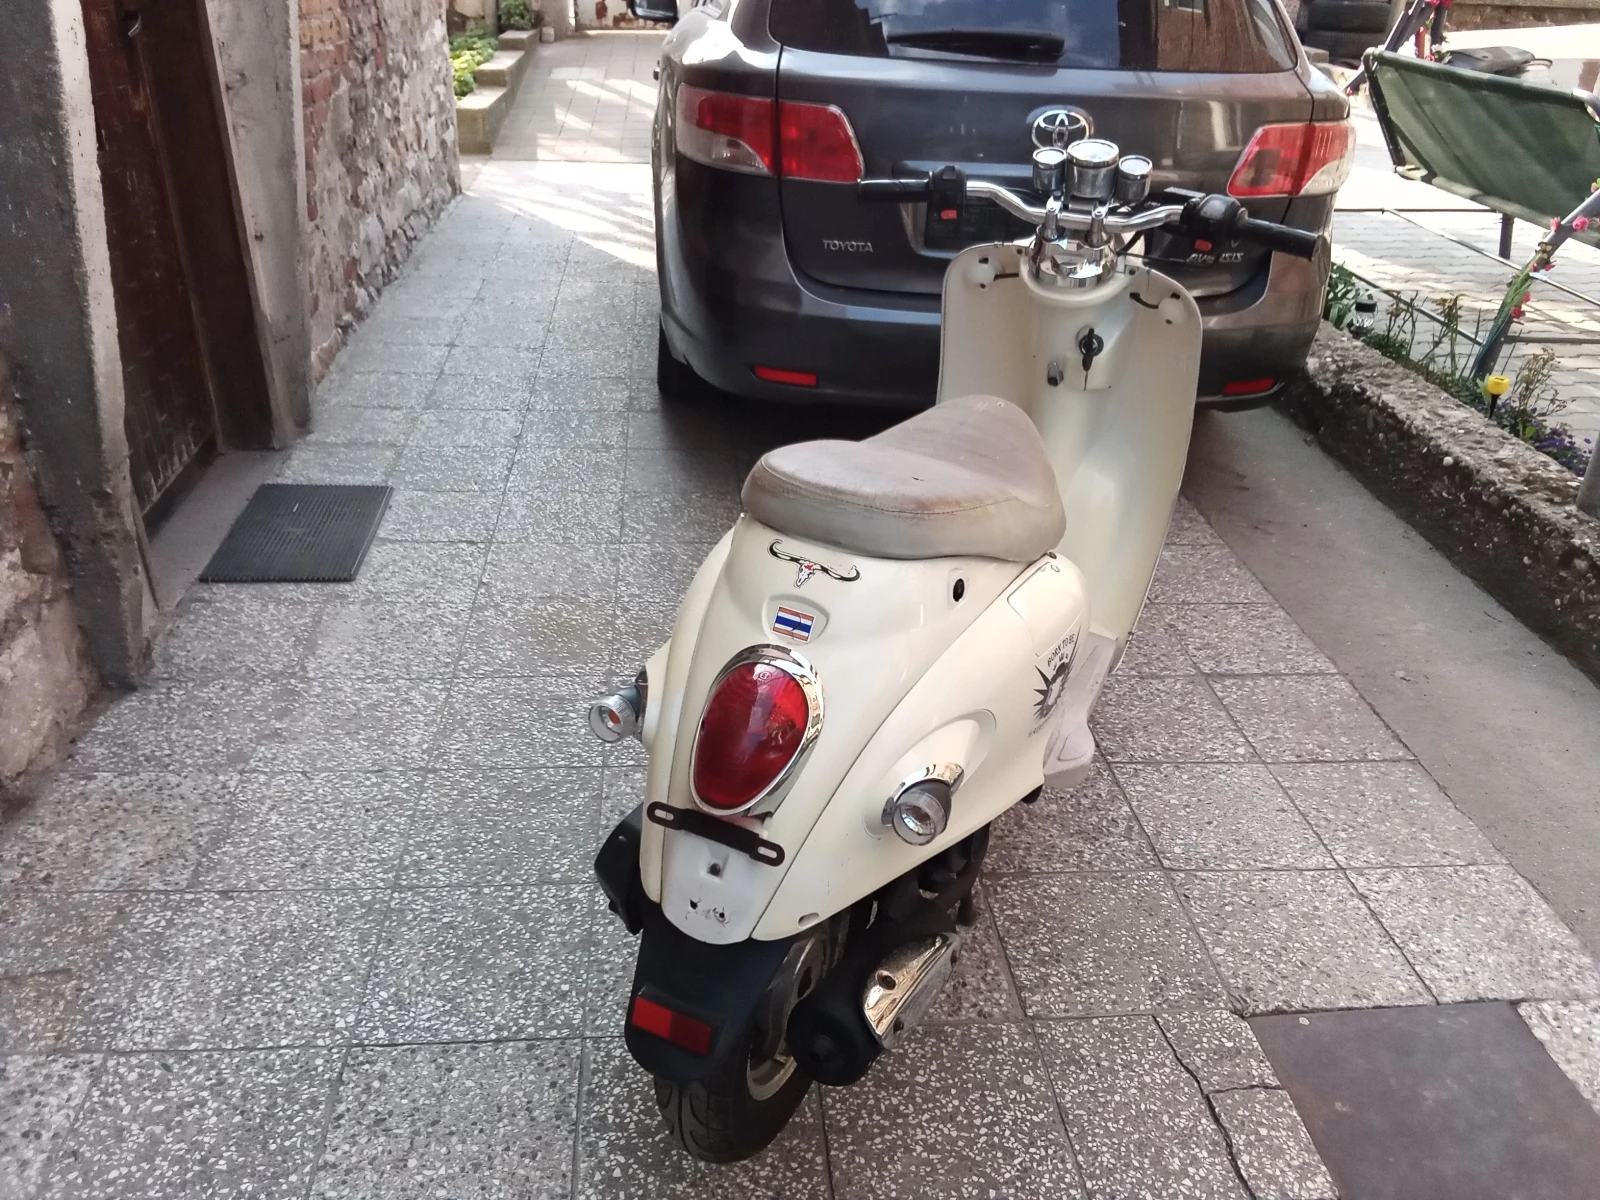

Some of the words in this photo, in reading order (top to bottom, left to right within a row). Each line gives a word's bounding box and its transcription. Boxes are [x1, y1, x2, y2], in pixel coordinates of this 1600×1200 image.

[822, 240, 874, 252] TOYOTA
[1047, 643, 1062, 667] BORN
[1062, 637, 1069, 649] TO
